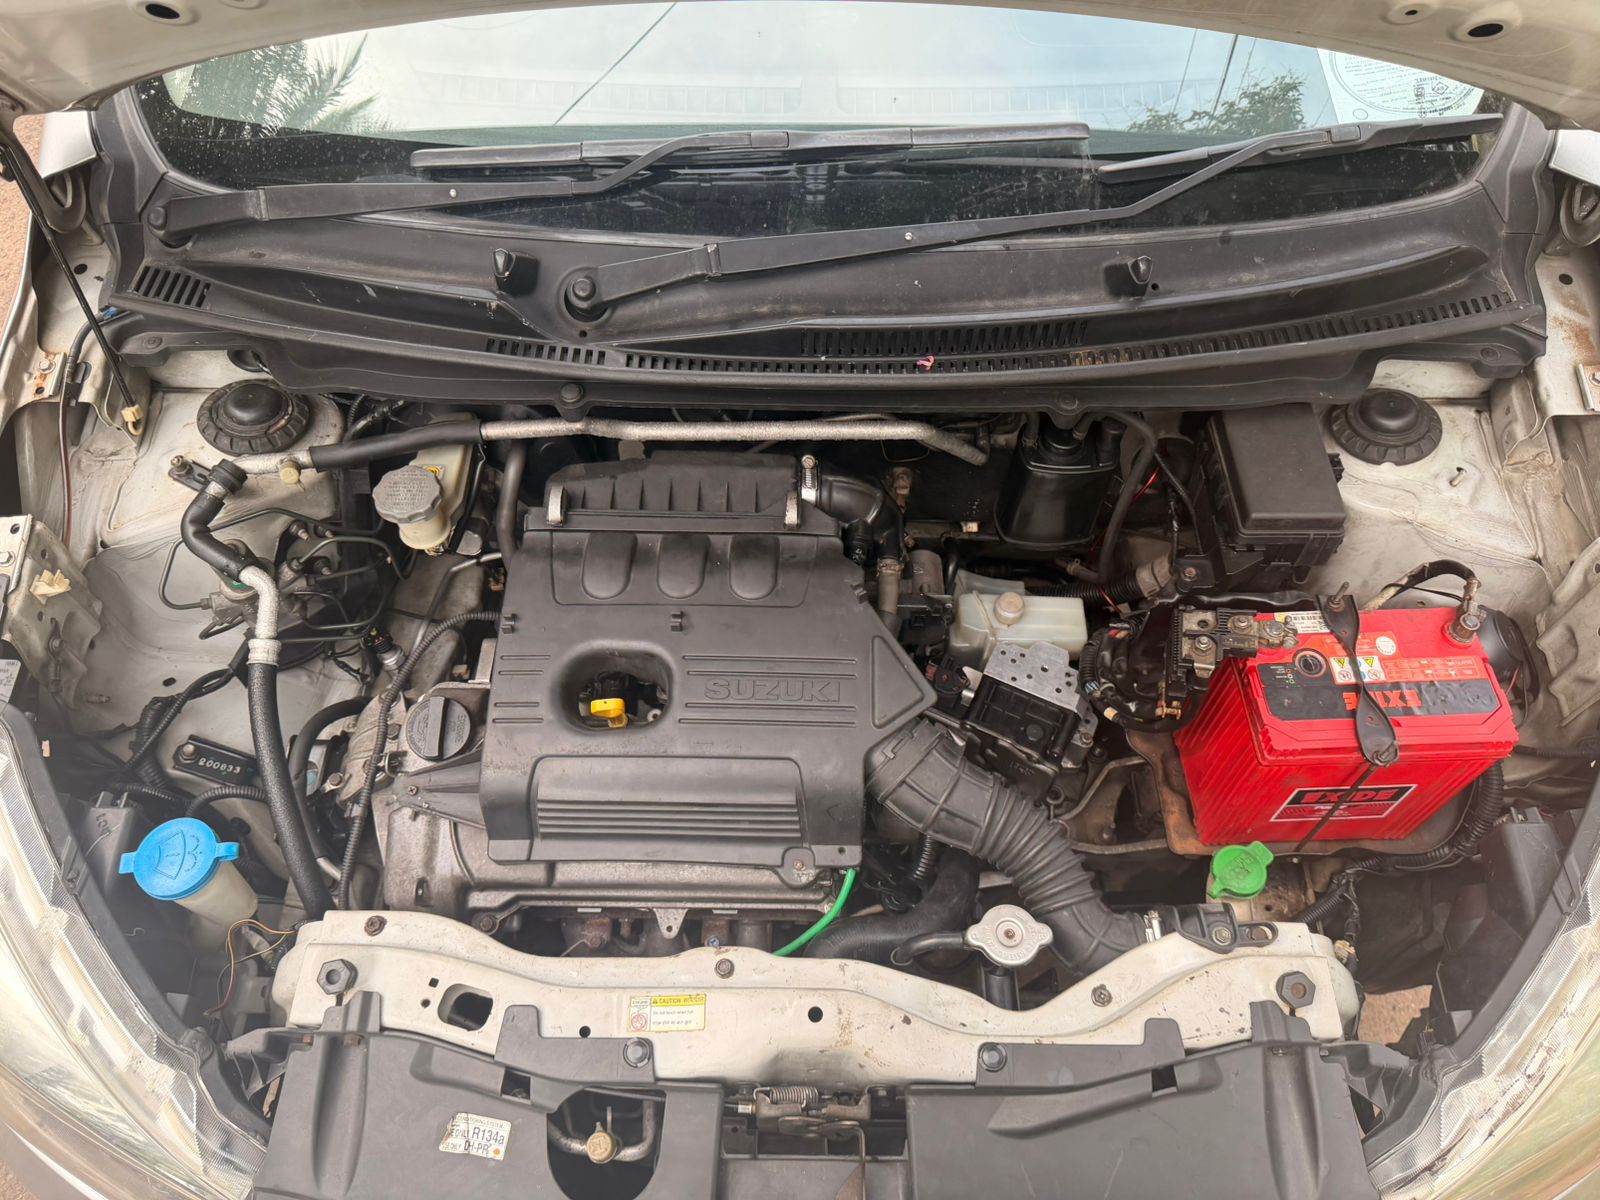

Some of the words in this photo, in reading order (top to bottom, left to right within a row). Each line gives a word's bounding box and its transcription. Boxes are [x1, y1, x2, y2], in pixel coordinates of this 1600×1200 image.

[704, 679, 841, 703] SUZUKI
[1342, 689, 1422, 711] EXIE
[471, 1126, 505, 1145] R134a
